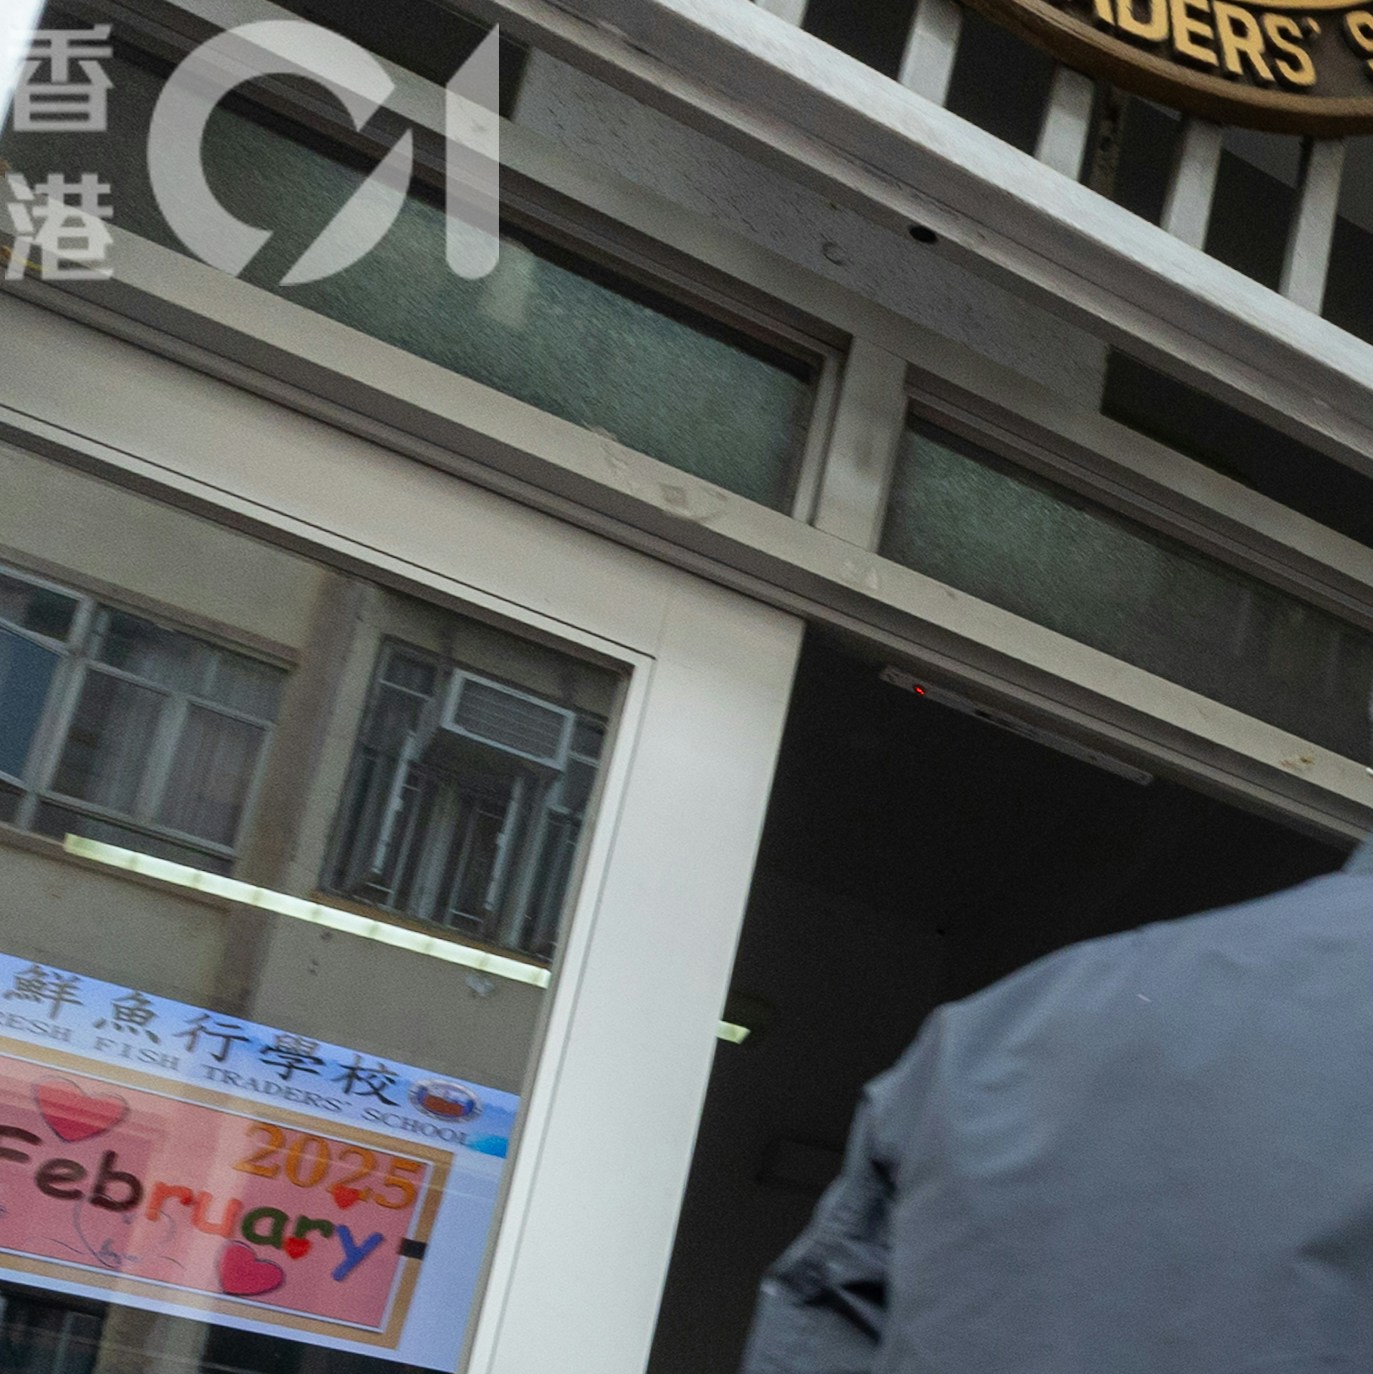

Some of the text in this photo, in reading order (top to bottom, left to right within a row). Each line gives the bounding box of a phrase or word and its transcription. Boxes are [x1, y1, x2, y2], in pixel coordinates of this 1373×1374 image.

[0, 1011, 470, 1147] ESH FISH TRADERS' SCHOOL
[2, 962, 401, 1108] 鮮魚行學校
[232, 1122, 424, 1210] 2025
